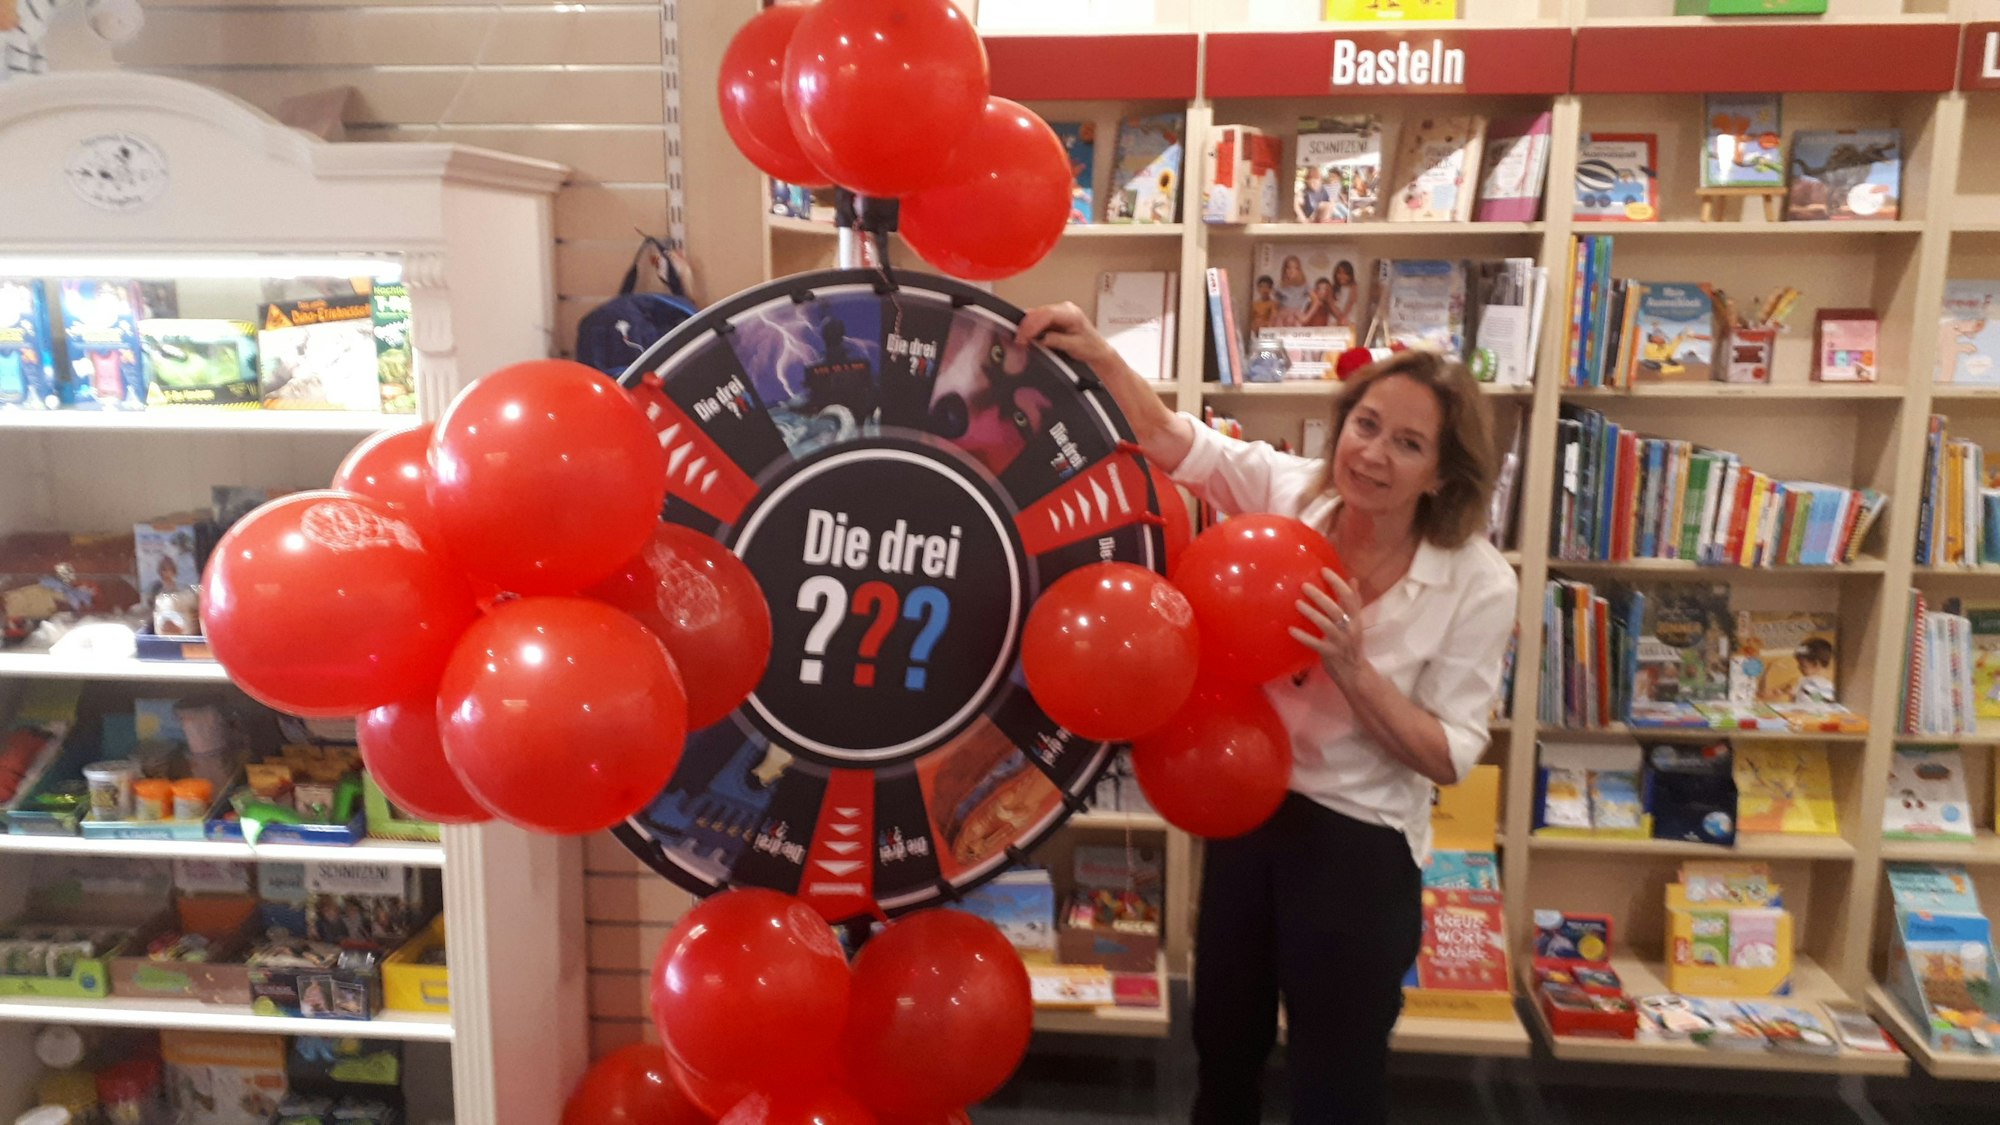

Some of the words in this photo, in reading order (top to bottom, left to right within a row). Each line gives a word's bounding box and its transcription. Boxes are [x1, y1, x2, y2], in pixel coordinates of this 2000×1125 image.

[1331, 39, 1465, 85] Basteln
[887, 333, 909, 356] Die
[909, 337, 937, 360] drei
[693, 397, 722, 422] Die
[715, 374, 745, 406] drei
[1049, 421, 1069, 448] Die
[1061, 442, 1088, 470] drei
[803, 509, 871, 570] Die
[878, 519, 962, 579] drei
[1098, 536, 1116, 559] Die
[753, 832, 782, 857] drei
[780, 841, 806, 865] Die
[879, 843, 907, 866] drei
[906, 836, 929, 857] Die
